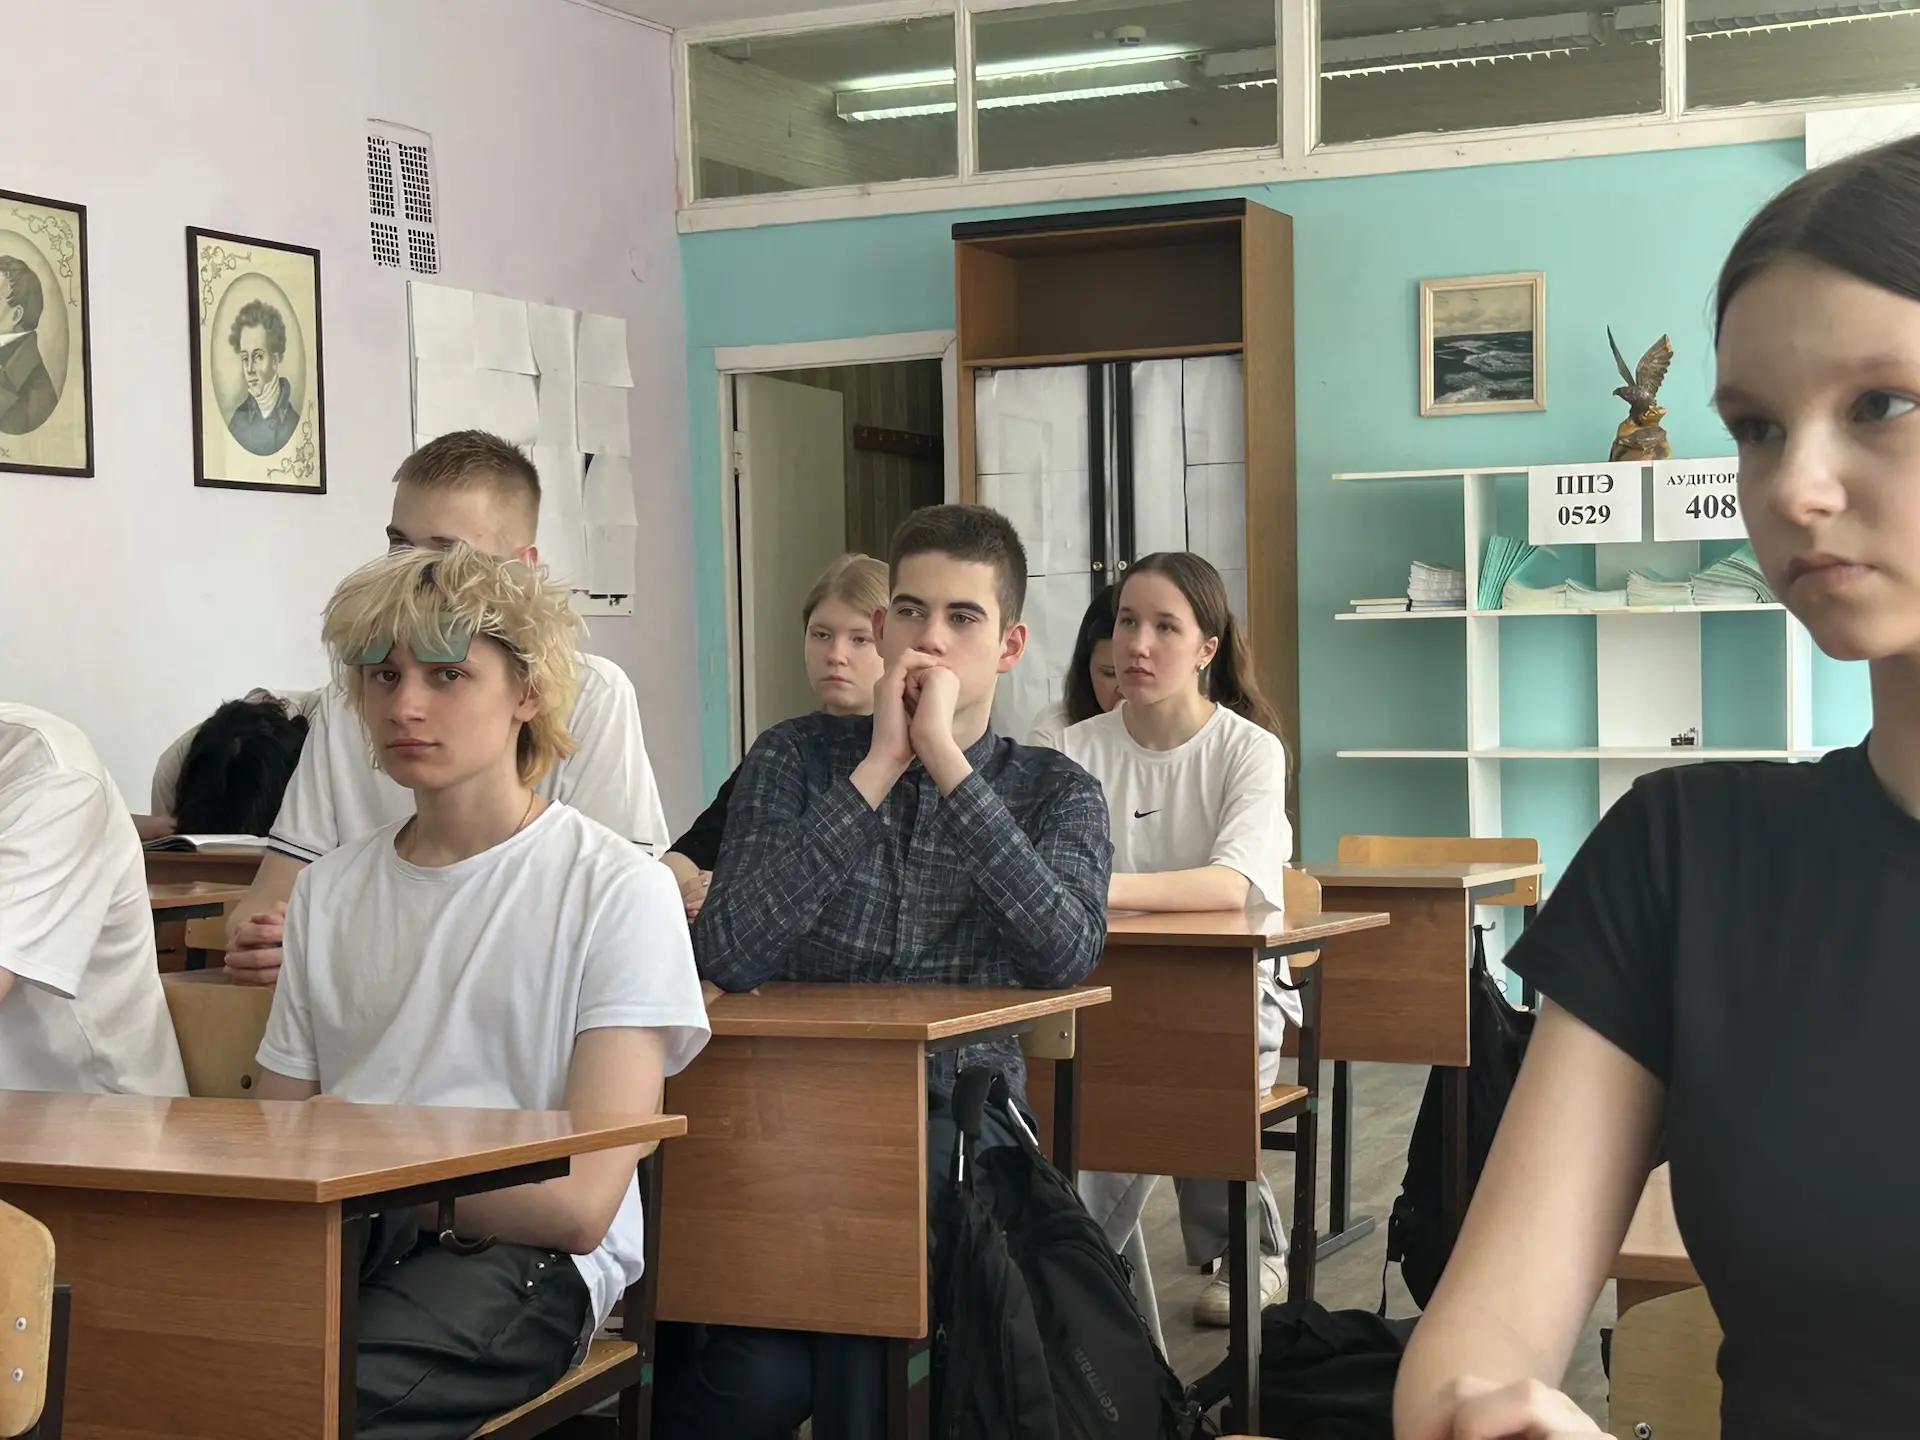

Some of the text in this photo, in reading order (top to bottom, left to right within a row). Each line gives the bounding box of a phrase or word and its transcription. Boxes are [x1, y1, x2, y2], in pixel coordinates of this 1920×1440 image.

[1555, 474, 1614, 495] ППЭ
[1666, 473, 1739, 487] АУДИТОР
[1558, 504, 1611, 525] 0529
[1685, 494, 1737, 519] 408
